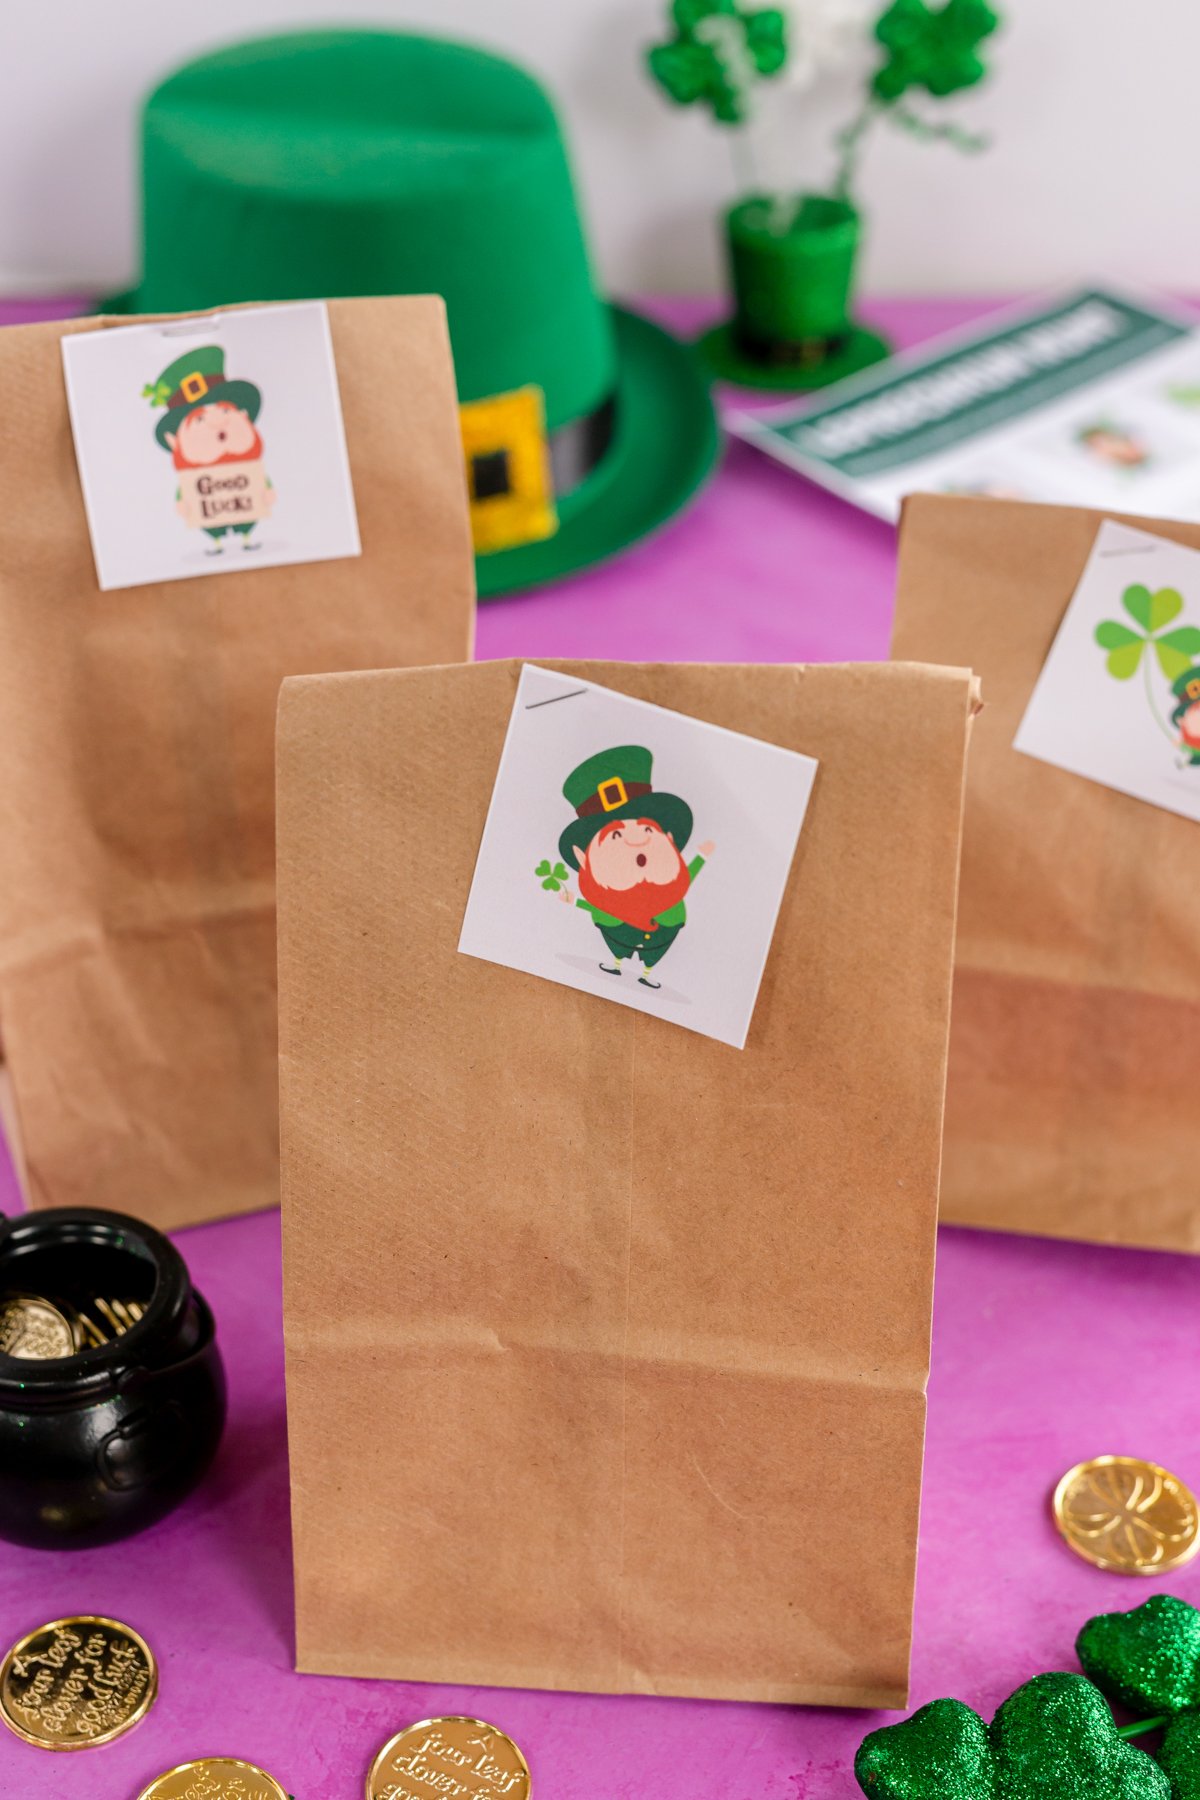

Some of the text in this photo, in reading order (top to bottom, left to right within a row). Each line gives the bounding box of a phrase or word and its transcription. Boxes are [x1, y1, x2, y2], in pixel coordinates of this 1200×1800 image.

[40, 1628, 81, 1668] leaf
[43, 1633, 107, 1732] clover for
[77, 1682, 113, 1737] good
[391, 1754, 468, 1796] clover
[409, 1733, 472, 1767] four
[470, 1754, 525, 1793] leaf
